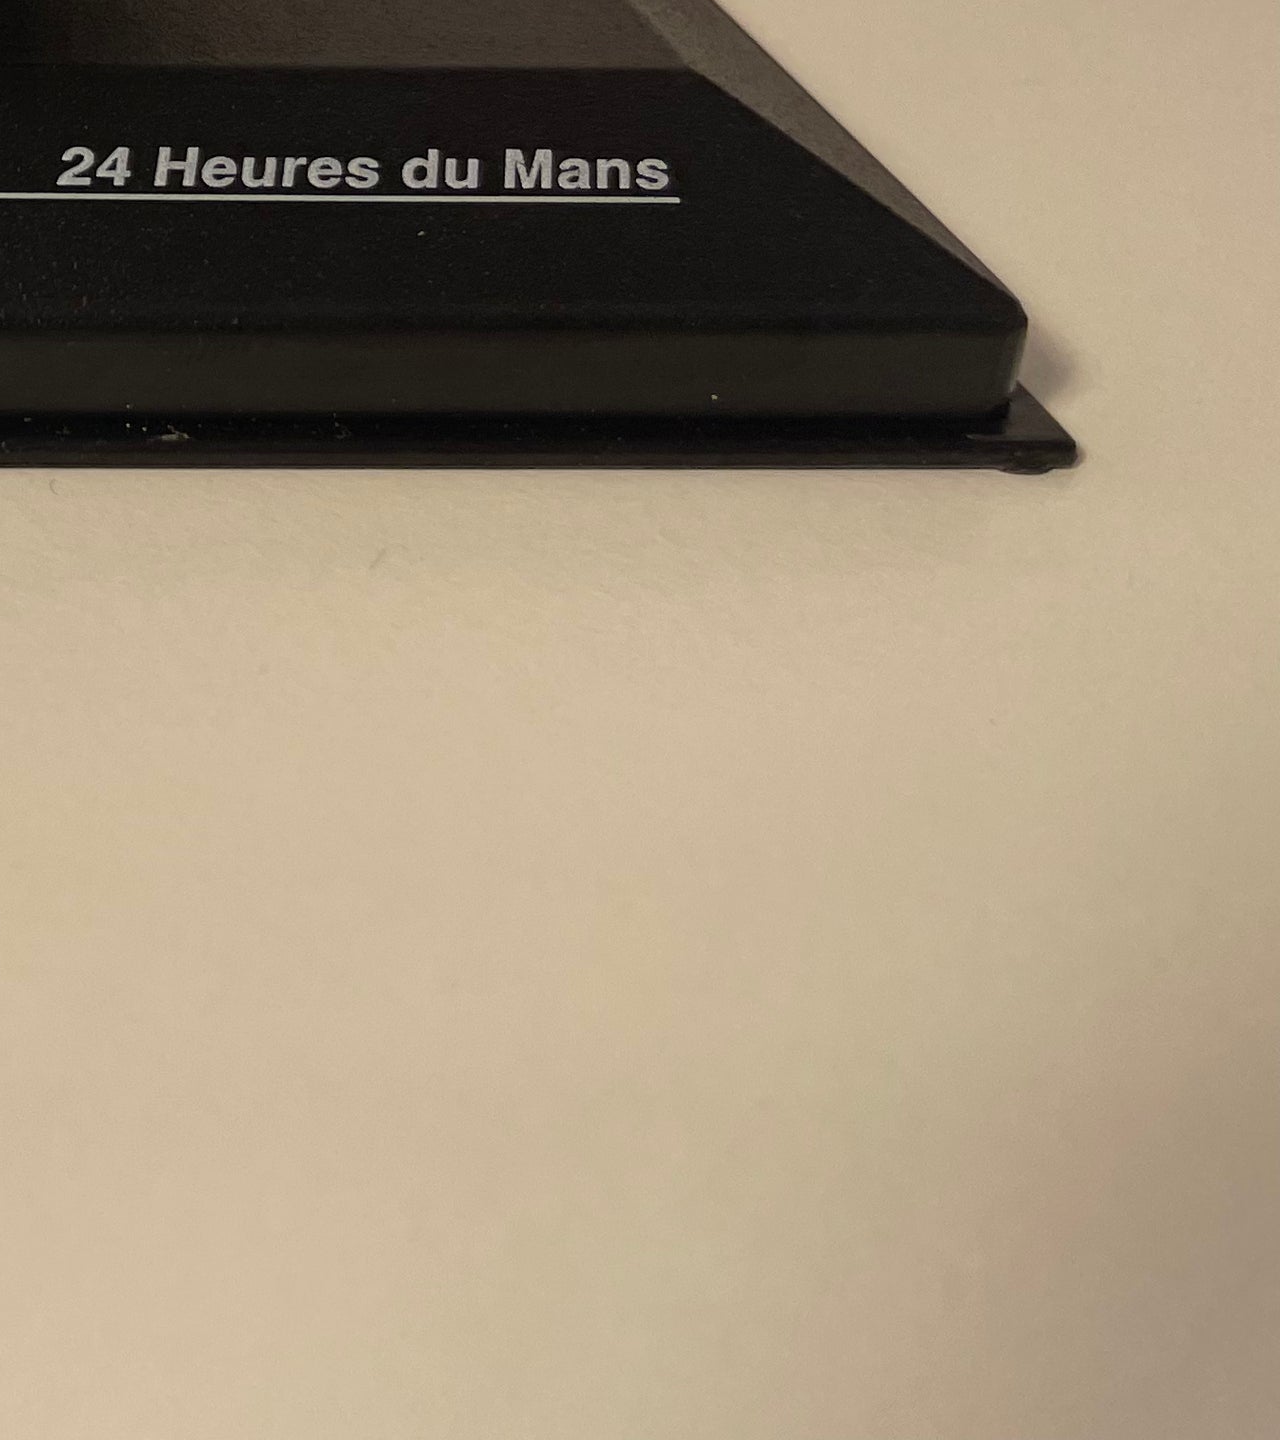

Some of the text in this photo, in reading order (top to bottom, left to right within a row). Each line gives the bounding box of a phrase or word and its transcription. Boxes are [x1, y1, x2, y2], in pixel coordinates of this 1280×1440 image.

[56, 146, 670, 190] 24 Heures du Mans
